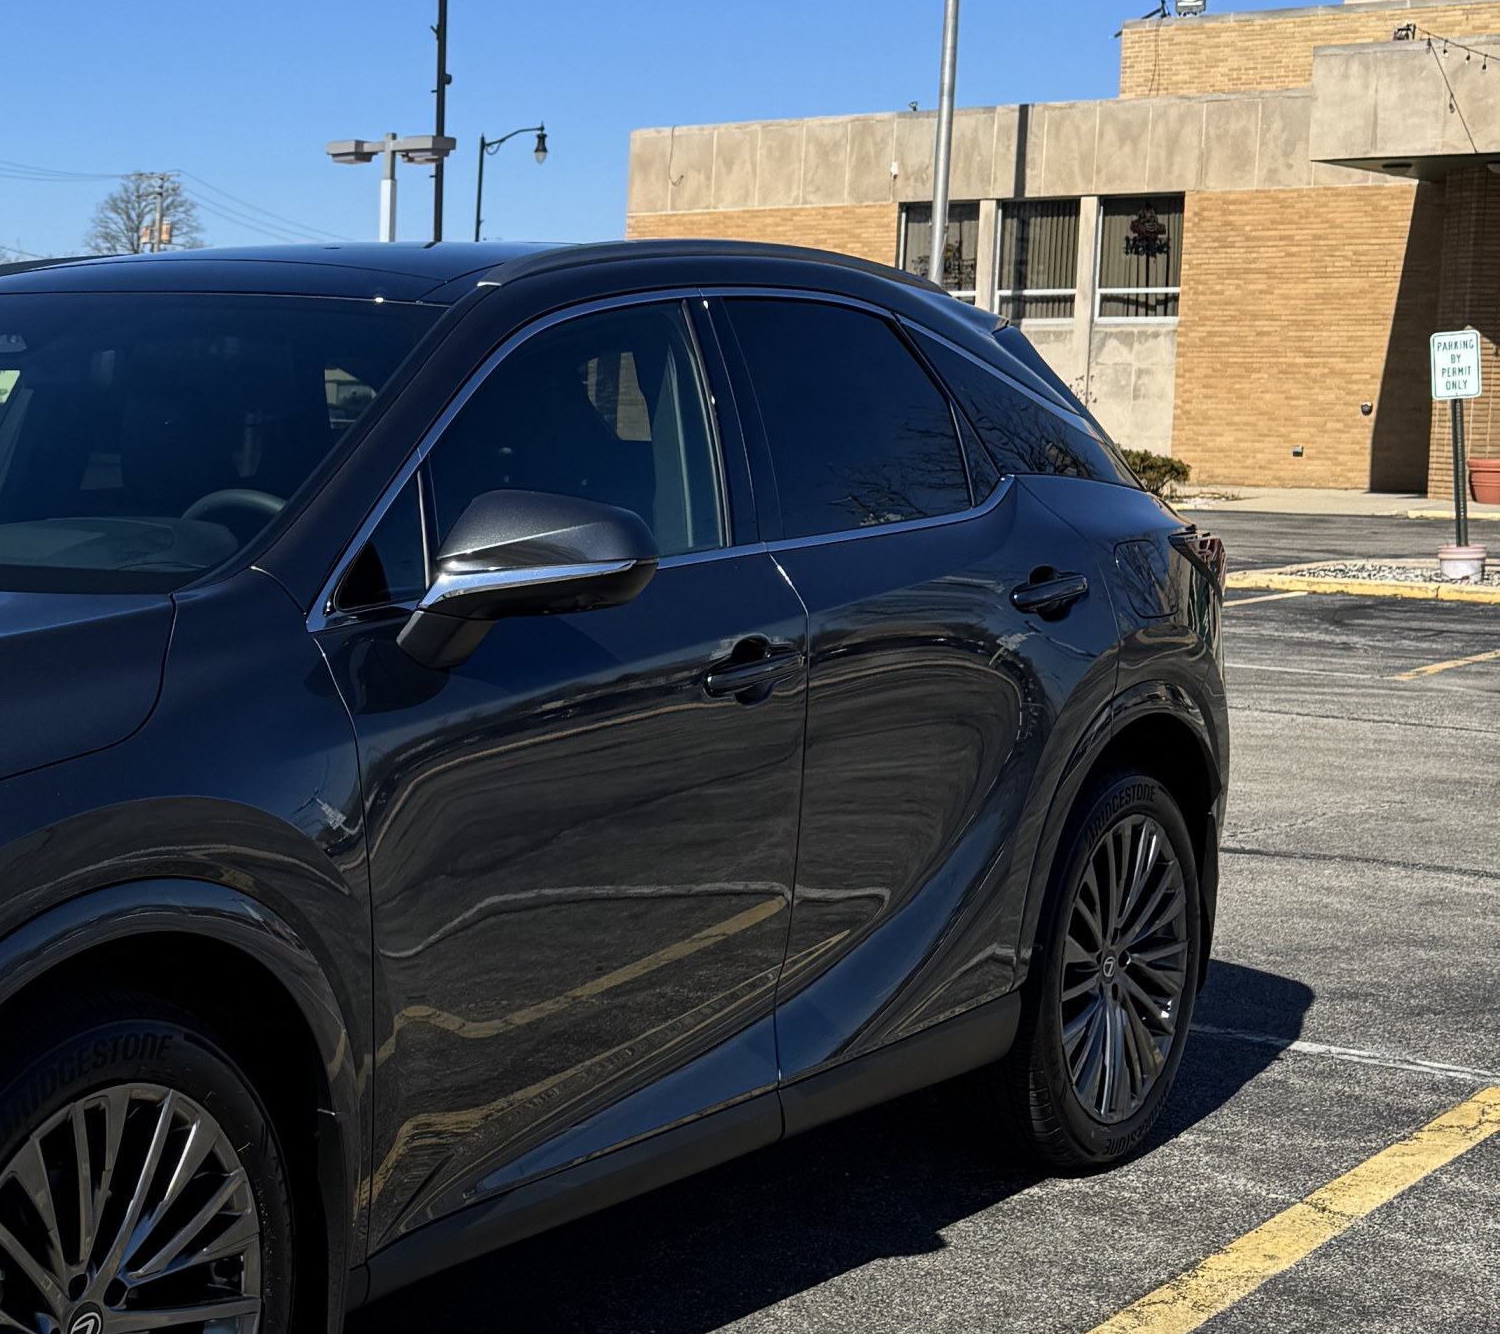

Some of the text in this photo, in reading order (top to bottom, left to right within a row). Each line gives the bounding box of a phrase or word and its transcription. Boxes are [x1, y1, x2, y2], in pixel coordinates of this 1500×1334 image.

[1437, 339, 1474, 351] PARKING
[1451, 354, 1461, 363] BY
[1442, 366, 1471, 377] PERMIT
[1445, 380, 1468, 390] ONLY
